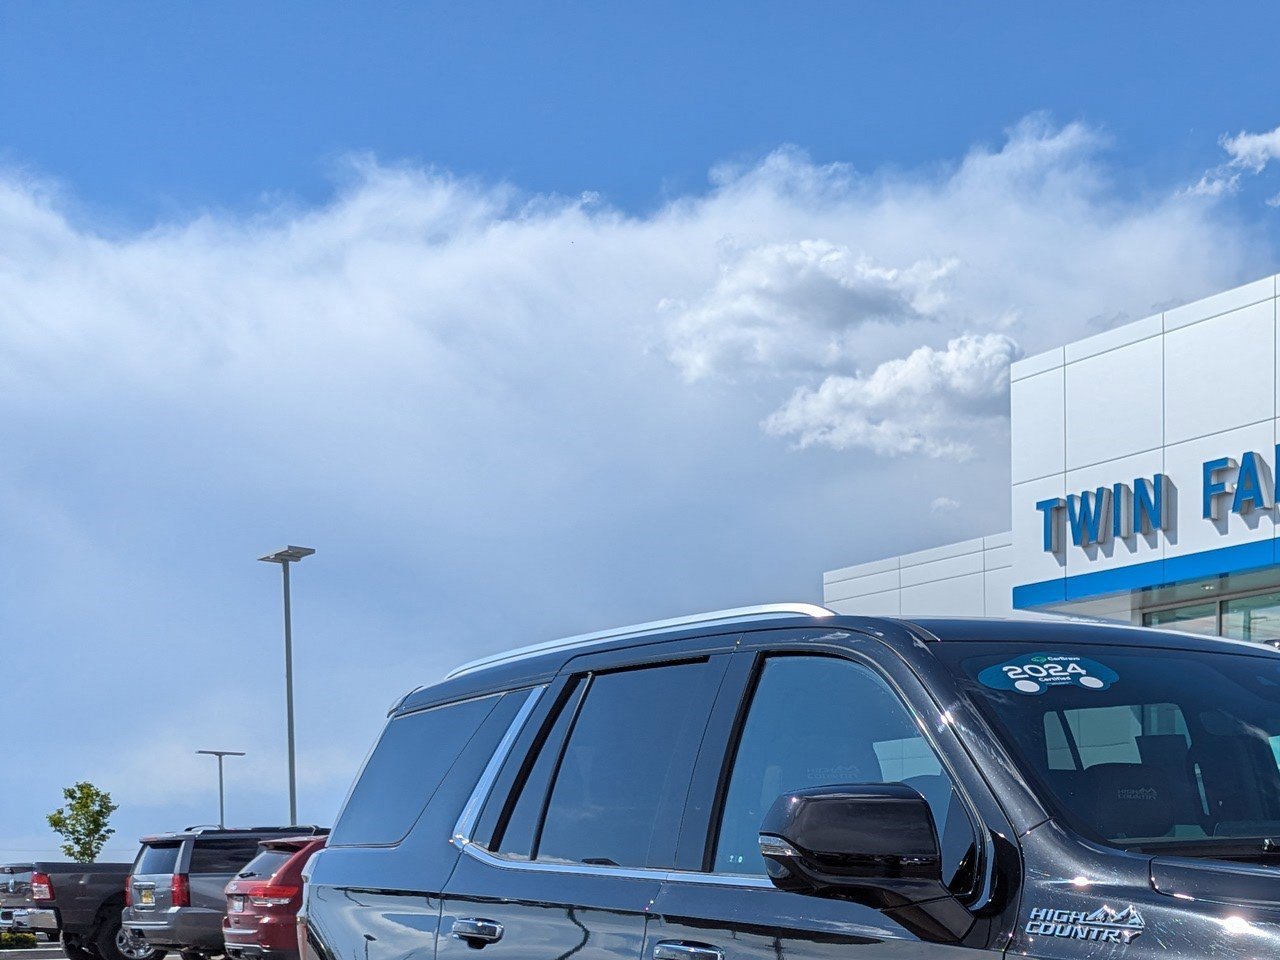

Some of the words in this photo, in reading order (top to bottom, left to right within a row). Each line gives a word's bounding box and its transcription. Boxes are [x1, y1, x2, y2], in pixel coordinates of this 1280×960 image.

[1036, 474, 1167, 553] TWIN
[1002, 663, 1087, 679] 2024
[1030, 907, 1087, 923] HIGH
[1025, 921, 1141, 944] COUNTRY
